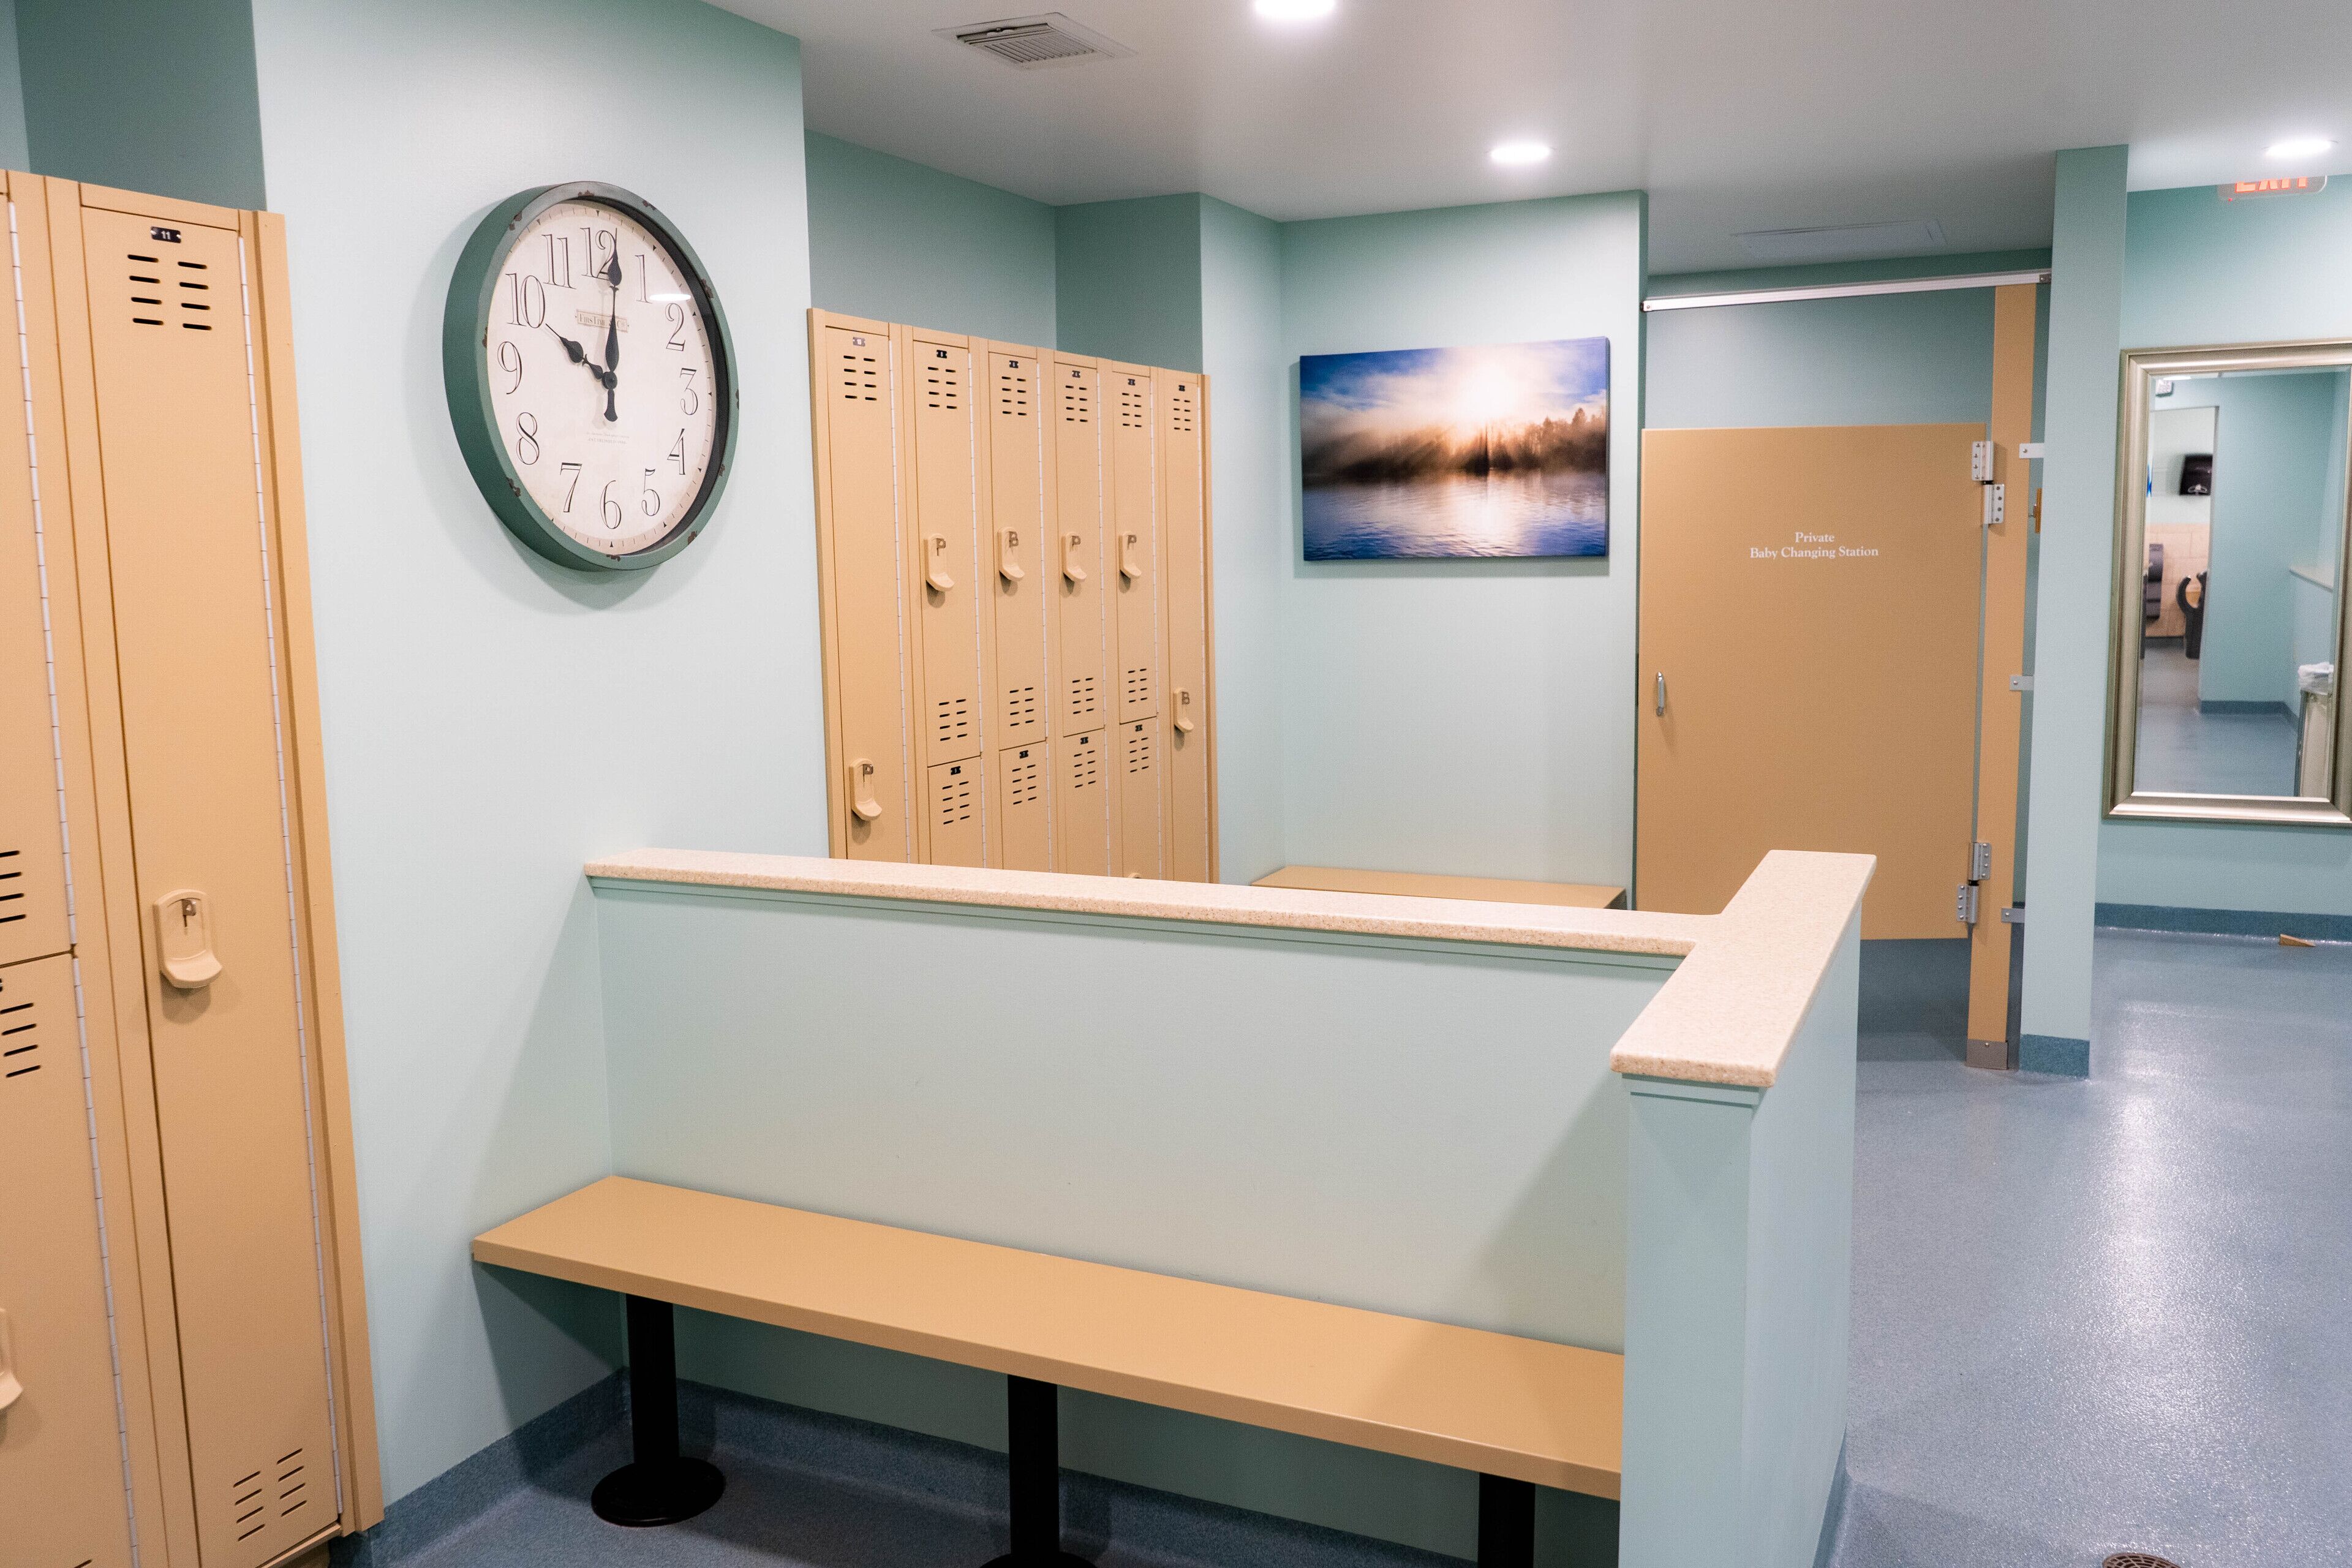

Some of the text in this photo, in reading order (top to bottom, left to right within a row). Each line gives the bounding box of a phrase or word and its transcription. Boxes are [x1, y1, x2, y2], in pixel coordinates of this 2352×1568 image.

[160, 230, 171, 239] 11
[579, 227, 617, 281] 12
[541, 233, 576, 290] 11
[635, 254, 652, 304] 1
[505, 273, 546, 329] 10
[665, 303, 686, 352] 2
[497, 341, 522, 395] 9
[679, 368, 699, 416] 3
[516, 412, 540, 466] 8
[666, 428, 686, 475] 4
[559, 462, 582, 513] 7
[600, 480, 622, 530] 6
[641, 468, 661, 517] 5
[1750, 546, 1879, 560] Baby Changing Station
[1795, 532, 1835, 543] Private
